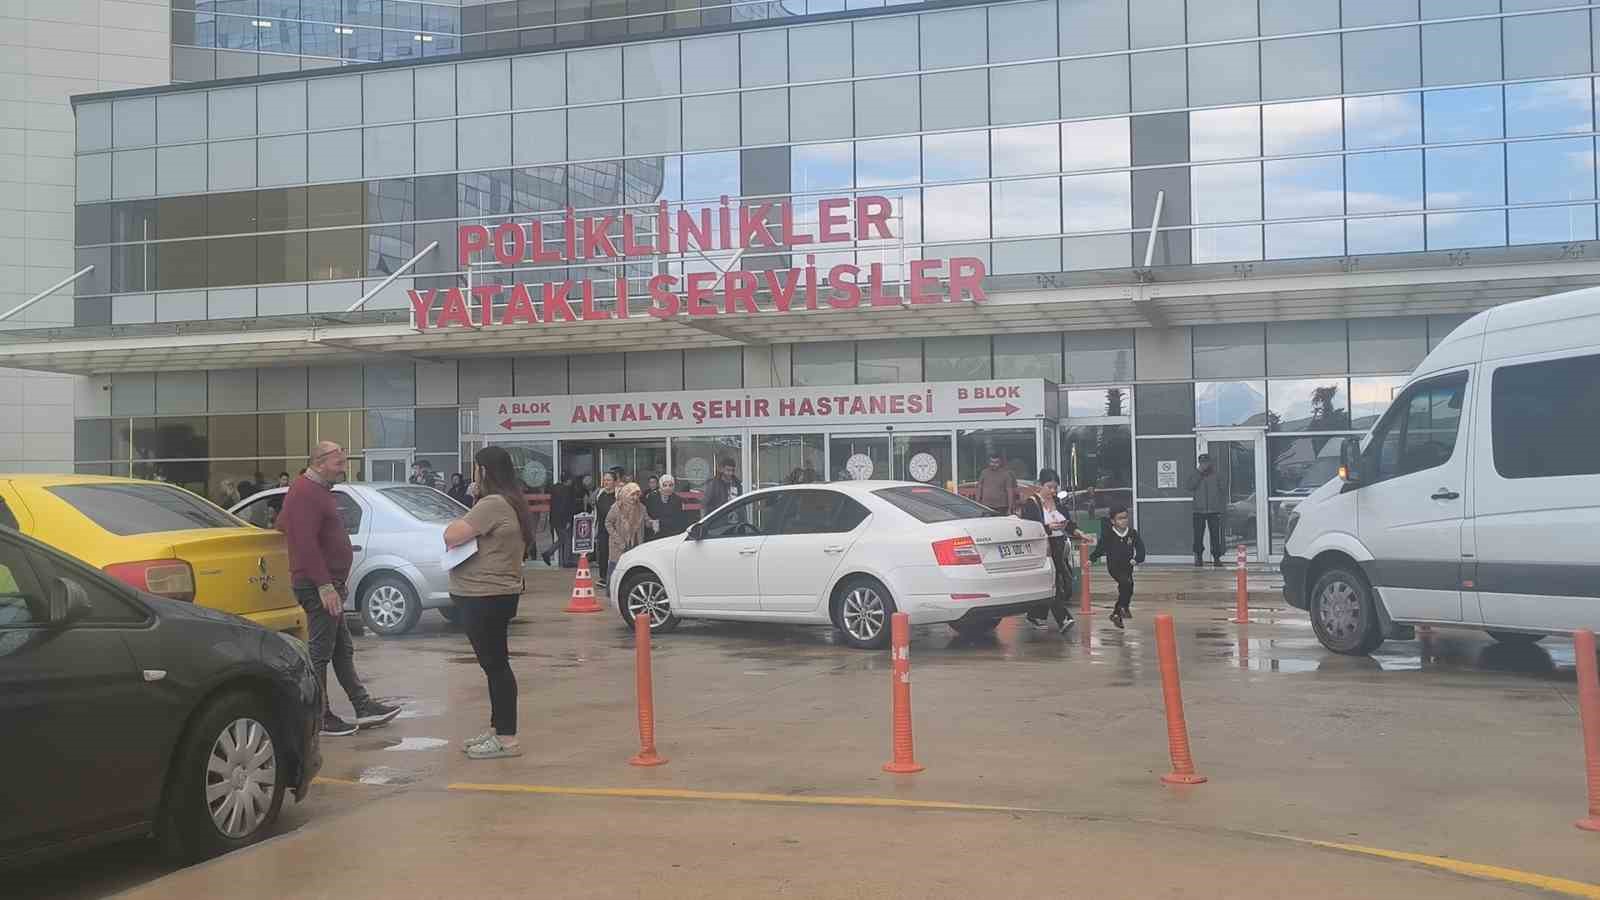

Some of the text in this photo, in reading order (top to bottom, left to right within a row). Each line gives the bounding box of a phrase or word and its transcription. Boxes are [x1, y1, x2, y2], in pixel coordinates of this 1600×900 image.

[458, 195, 893, 265] POLİKLİNİKLER
[407, 254, 987, 331] YATAKLI SERVİSLER
[498, 402, 551, 414] A BLOK
[571, 390, 933, 424] ANTALYA ŞEHİR HASTANESİ
[958, 385, 1021, 400] B BLOK
